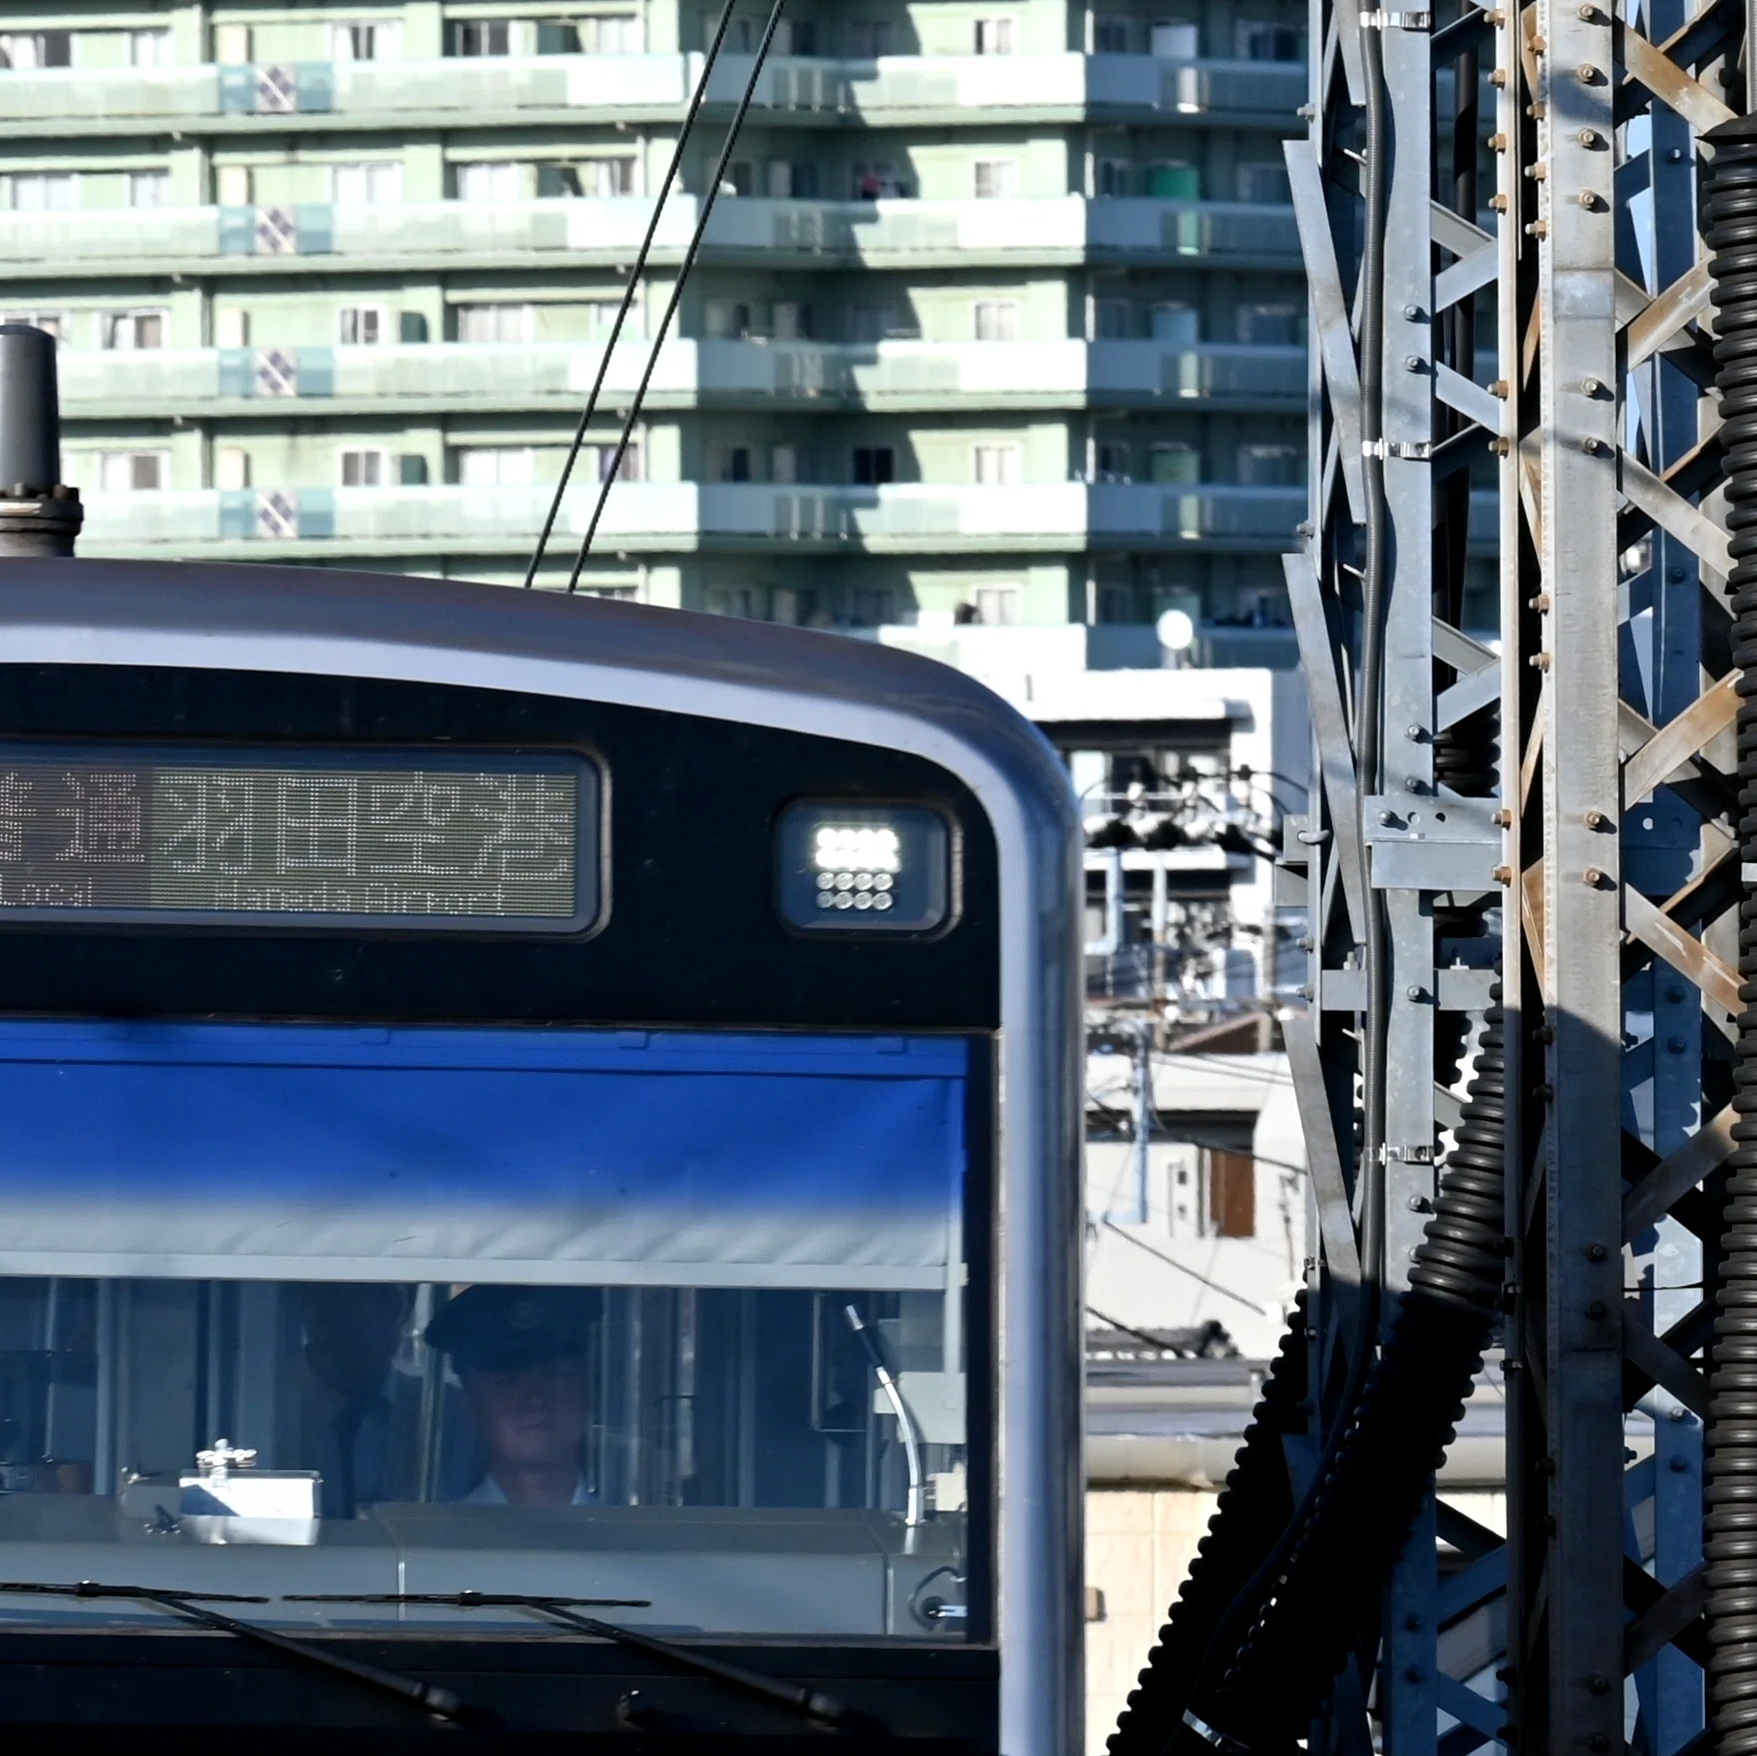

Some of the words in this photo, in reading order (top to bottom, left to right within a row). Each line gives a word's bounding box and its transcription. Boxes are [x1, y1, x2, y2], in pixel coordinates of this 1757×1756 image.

[159, 771, 570, 881] 羽田空港
[215, 880, 351, 913] Haneda
[365, 882, 506, 917] Airport
